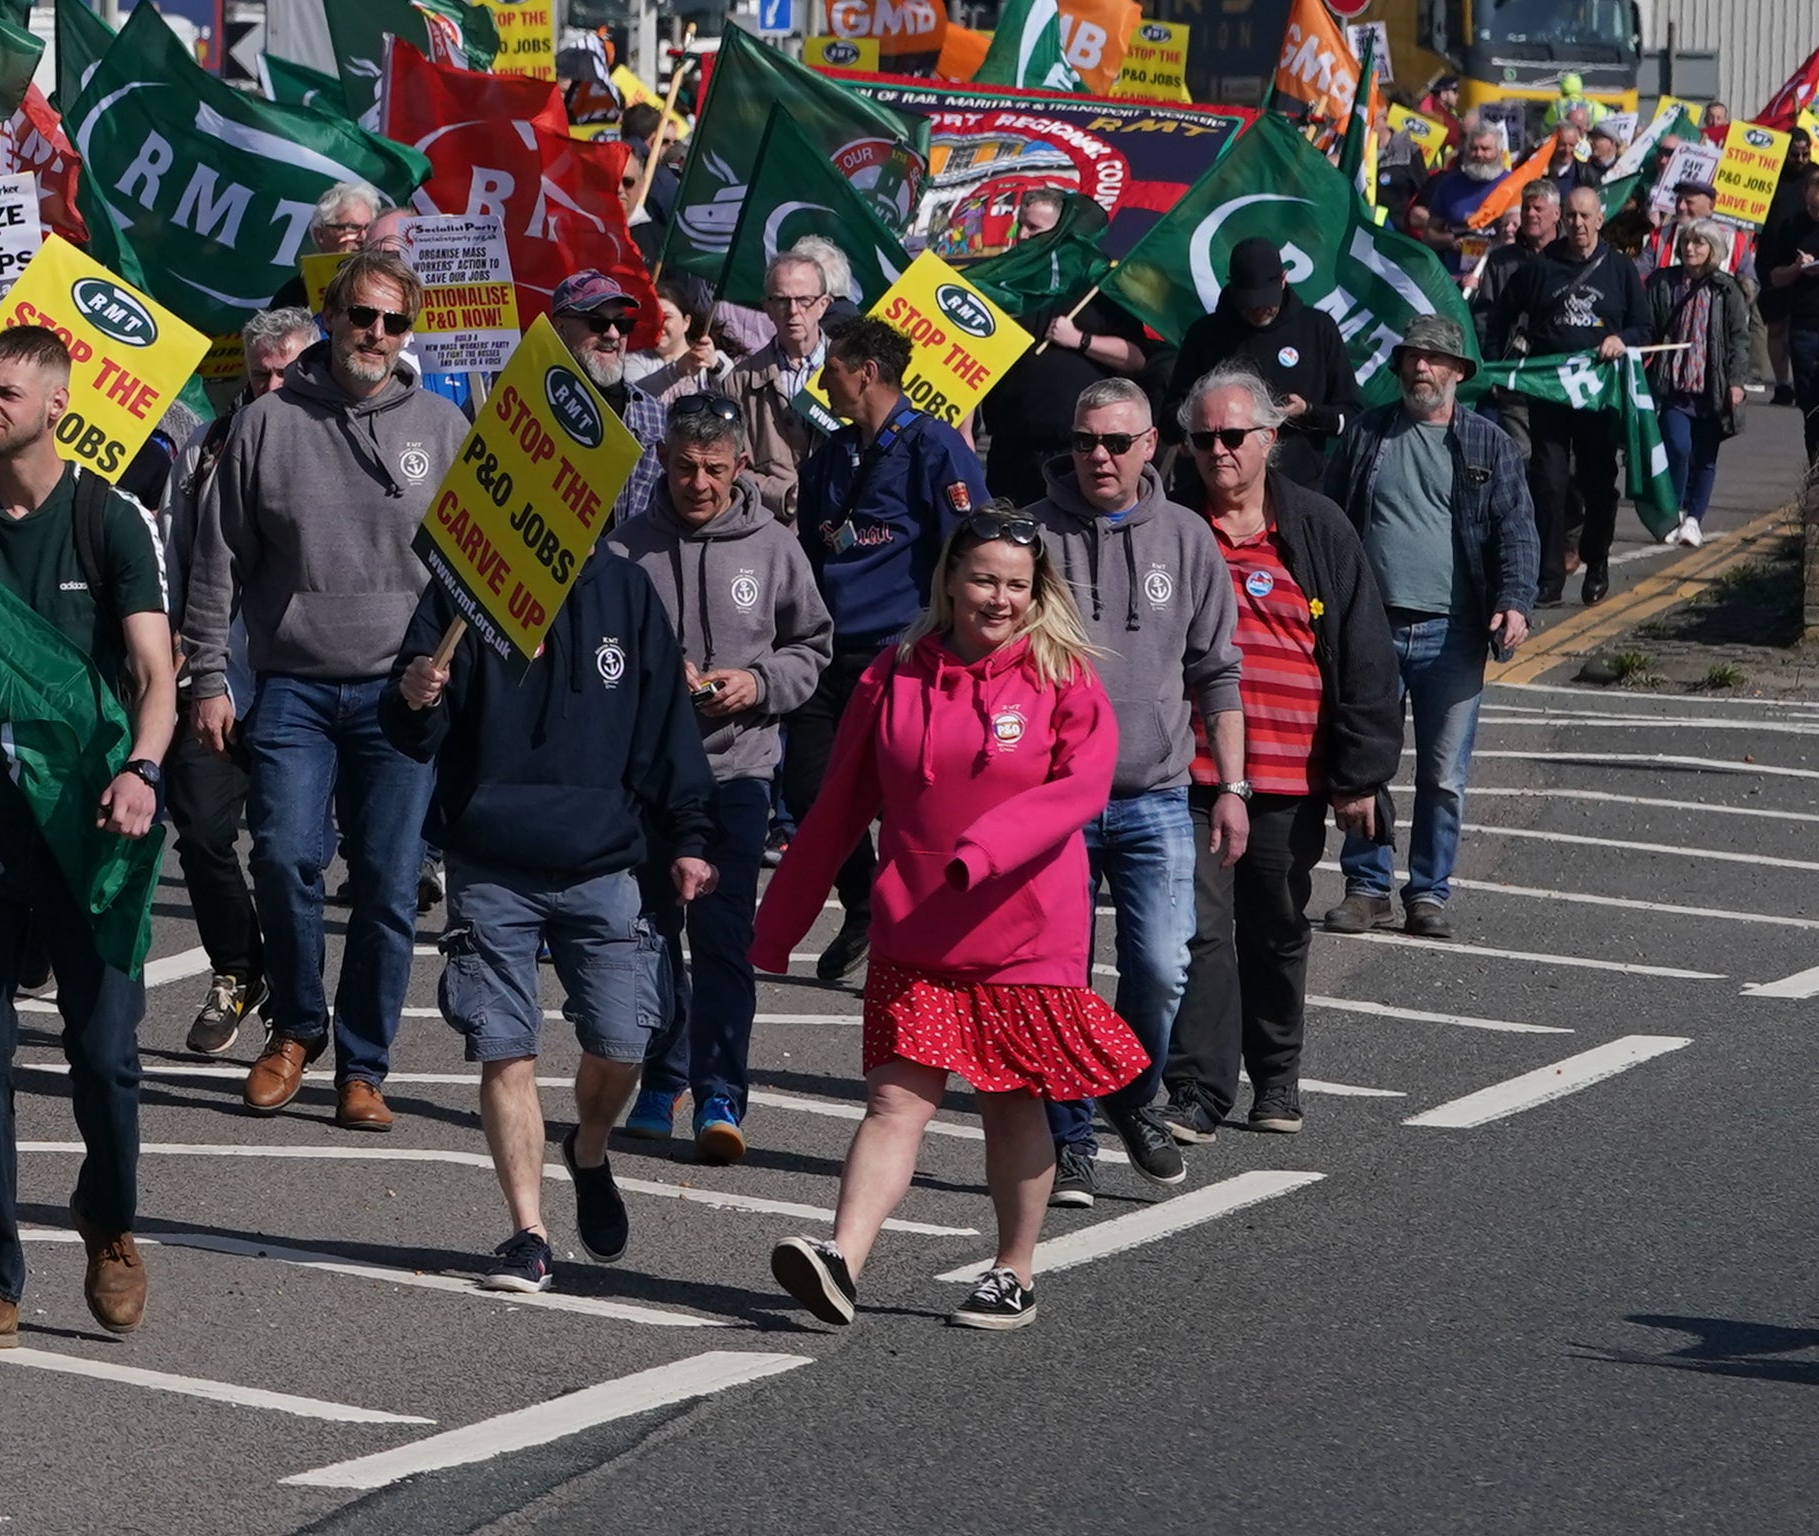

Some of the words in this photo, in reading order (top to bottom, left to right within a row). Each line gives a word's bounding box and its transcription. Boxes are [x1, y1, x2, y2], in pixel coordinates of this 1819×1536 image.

[522, 11, 548, 26] THE
[513, 38, 551, 55] JOBS
[1127, 46, 1155, 60] STOP
[1160, 49, 1181, 64] THE
[1121, 69, 1146, 83] P&O
[1150, 72, 1181, 87] JOBS
[877, 90, 898, 101] OF
[901, 91, 938, 105] RAIL
[1086, 117, 1222, 138] RMT
[1727, 147, 1756, 165] STOP
[1758, 156, 1780, 172] THE
[1717, 169, 1741, 186] P&O
[1744, 175, 1774, 194] JOBS
[114, 129, 320, 268] RMT
[1750, 201, 1767, 215] UP
[418, 247, 460, 260] ORGANISE
[462, 247, 487, 259] MASS
[457, 258, 487, 270] ACTION
[489, 258, 500, 269] TO
[425, 272, 447, 284] SAVE
[448, 271, 466, 283] OUR
[468, 270, 491, 282] JOBS
[86, 292, 144, 333] RMT
[426, 309, 458, 330] P&O
[461, 307, 503, 329] NOW!
[947, 294, 984, 329] RMT
[884, 296, 946, 350] STOP
[941, 342, 991, 391] THE
[92, 356, 160, 421] THE
[899, 373, 962, 425] JOBS
[554, 386, 594, 432] RMT
[55, 411, 128, 473] OBS
[496, 385, 555, 464] STOP
[550, 456, 602, 529] THE
[463, 432, 514, 508] P&O
[510, 502, 576, 586] JOBS
[437, 489, 511, 597] CARVE
[507, 580, 547, 632] UP
[427, 549, 512, 662] www.rmt.org.uk
